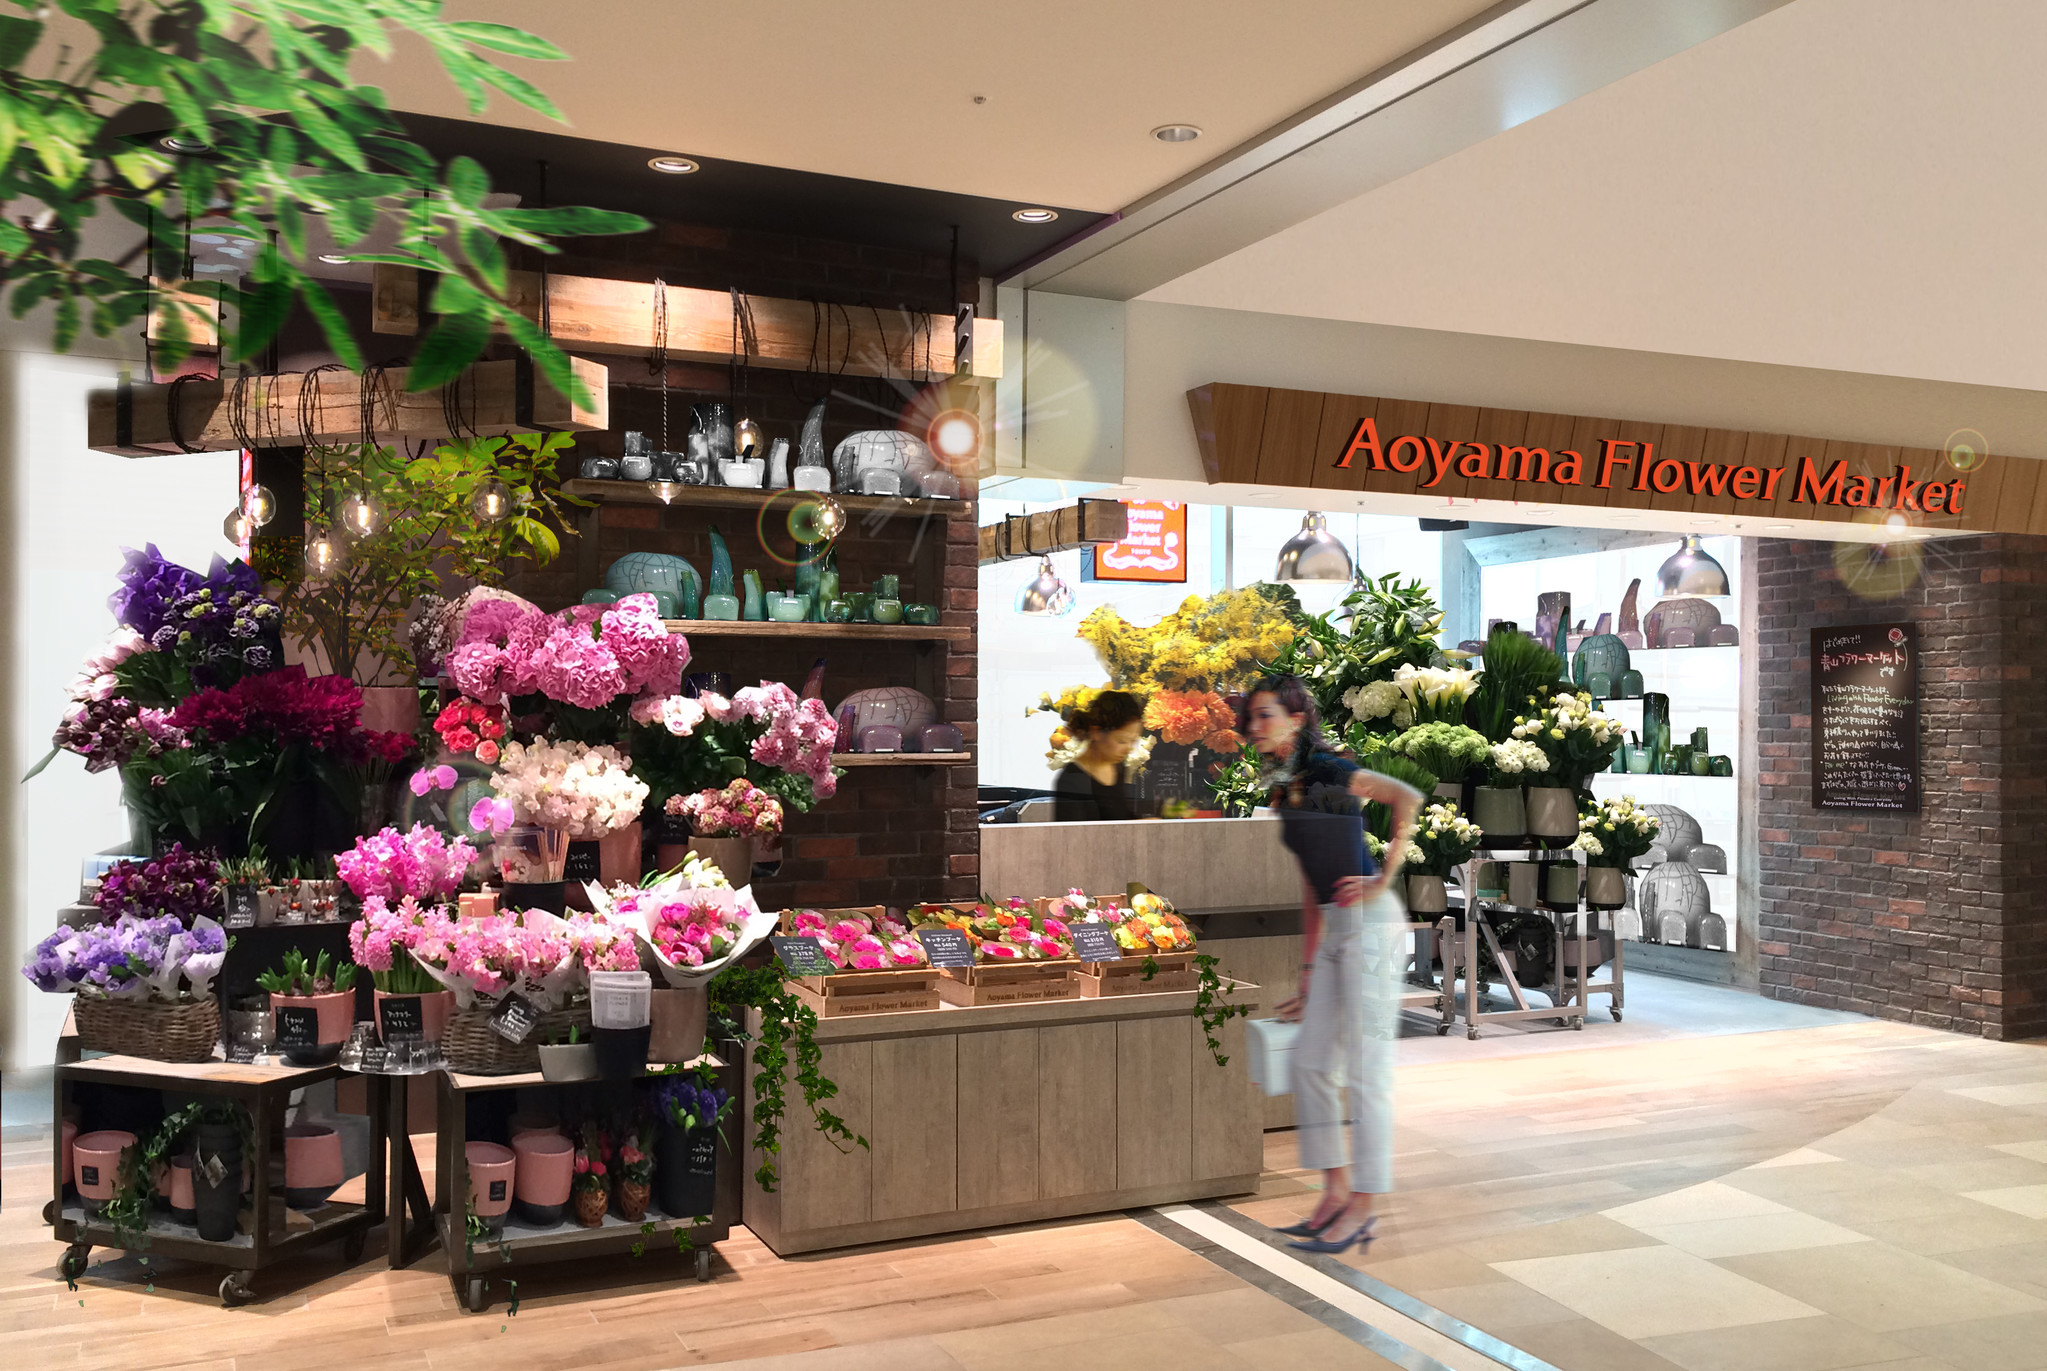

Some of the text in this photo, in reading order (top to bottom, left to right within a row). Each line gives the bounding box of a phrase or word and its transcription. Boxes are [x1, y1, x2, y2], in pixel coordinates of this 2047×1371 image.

[1335, 418, 1967, 514] Aoyama Flower Market
[1128, 520, 1162, 534] lower
[987, 989, 1069, 1002] Aoyama Flower Market
[839, 999, 928, 1013] Aoyama Flower Market
